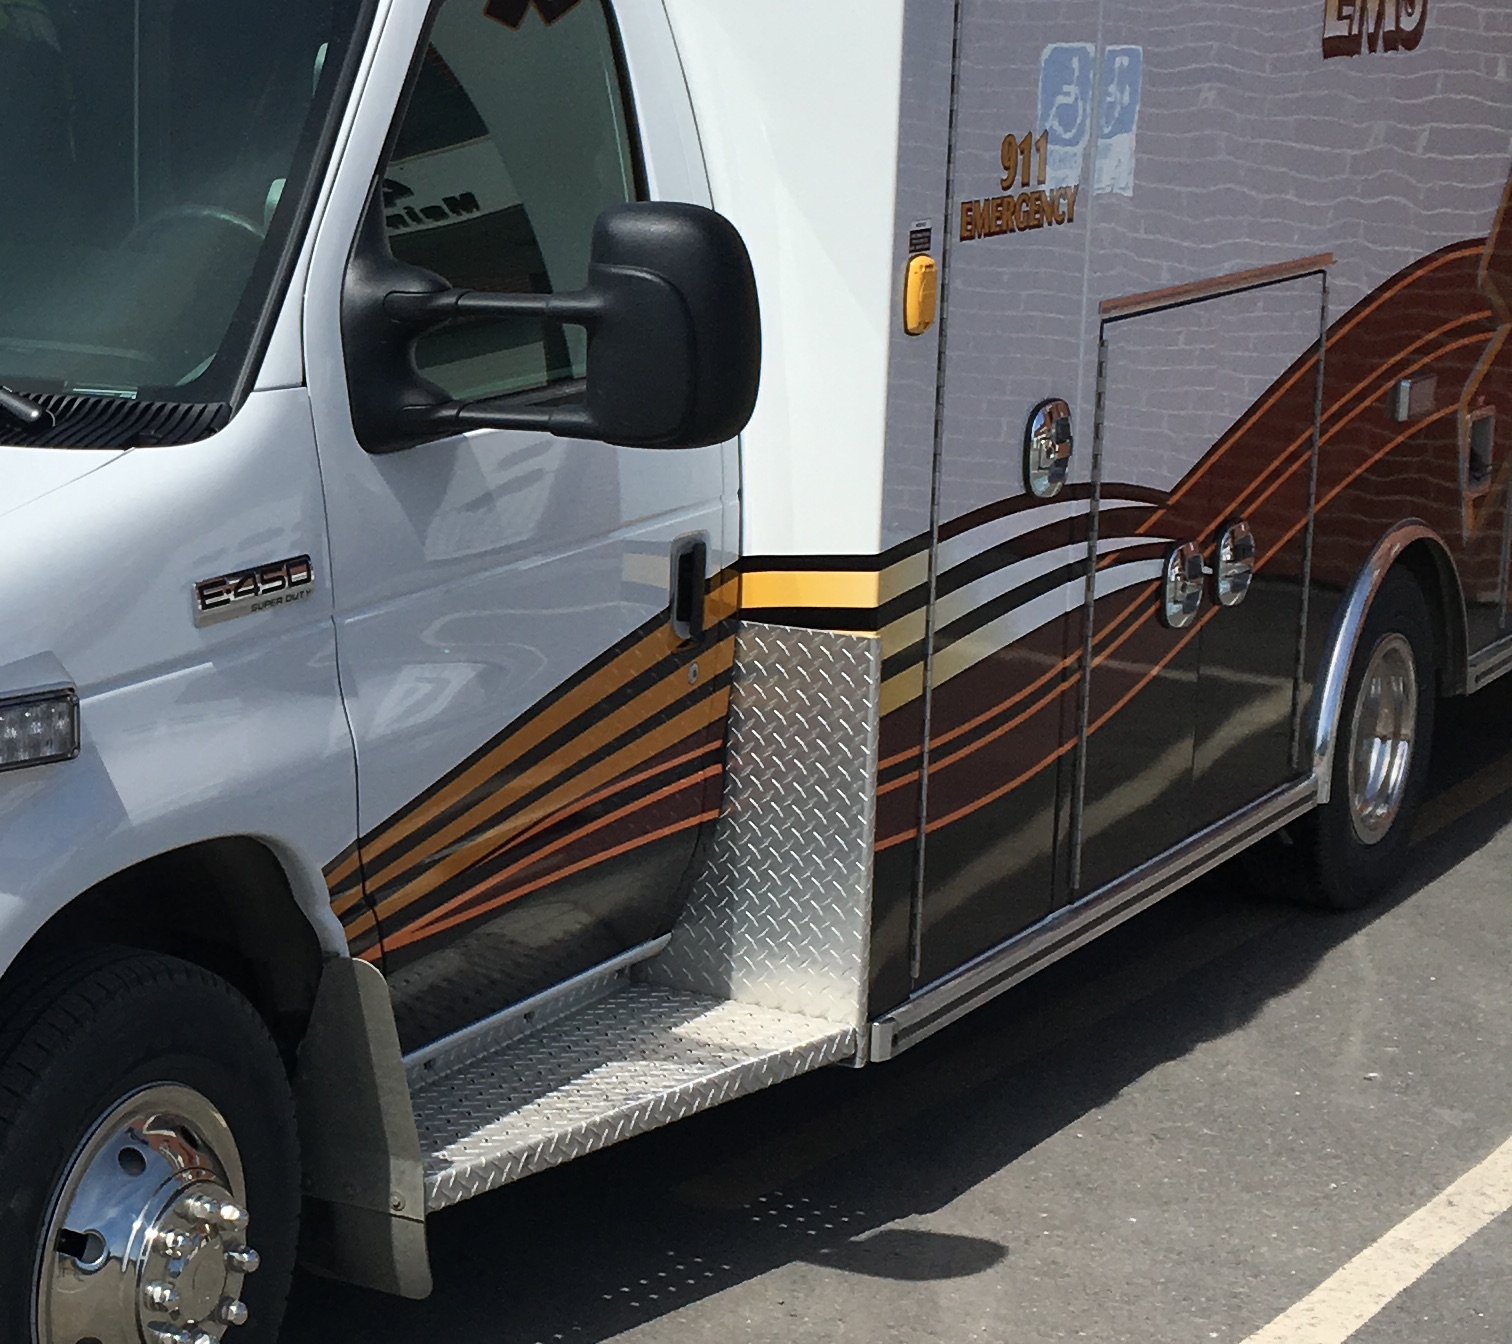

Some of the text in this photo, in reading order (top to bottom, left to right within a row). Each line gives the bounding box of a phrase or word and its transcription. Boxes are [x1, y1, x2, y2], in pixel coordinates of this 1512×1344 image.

[1000, 129, 1048, 192] 911
[959, 184, 1080, 242] EMERGENCY
[250, 589, 312, 613] SUPER DUTY
